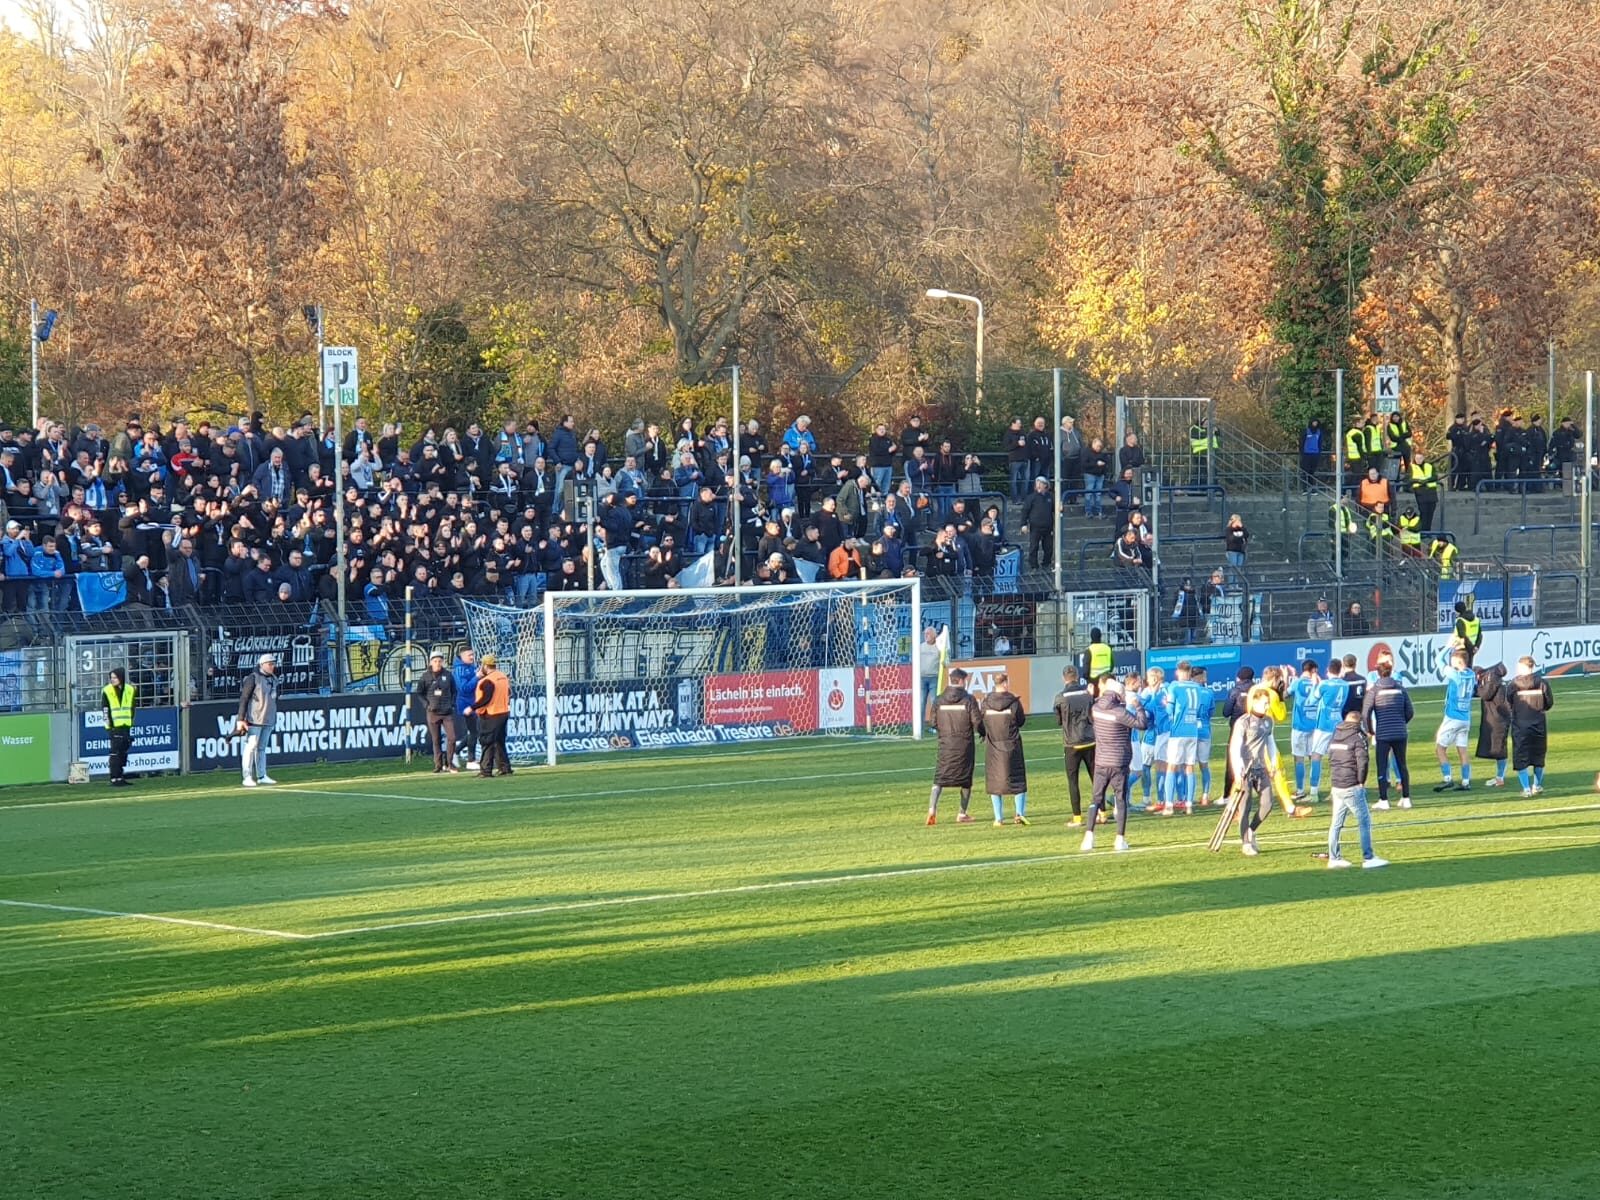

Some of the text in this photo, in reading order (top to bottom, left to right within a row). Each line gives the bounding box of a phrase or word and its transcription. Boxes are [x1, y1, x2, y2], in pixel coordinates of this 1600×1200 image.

[1380, 376, 1394, 396] K
[82, 651, 93, 671] 3
[710, 683, 804, 701] Lächeln ist einfach.
[1186, 687, 1198, 709] 11
[529, 695, 583, 716] DRNKS
[586, 694, 624, 713] MILK
[626, 691, 645, 710] AT
[648, 690, 660, 709] A
[275, 709, 326, 732] RINKS
[330, 706, 372, 728] MILK
[375, 705, 396, 725] AT
[507, 717, 543, 737] BALL
[600, 709, 674, 732] ANYWAY?
[1, 735, 34, 745] Wasser
[129, 724, 171, 736] EIN STYLE
[283, 730, 341, 752] MATCH
[345, 724, 428, 749] ANYWAY?
[635, 720, 793, 746] Eisenbach Tresore.de
[132, 735, 171, 747] RKWEAR
[544, 733, 631, 751] resore.de
